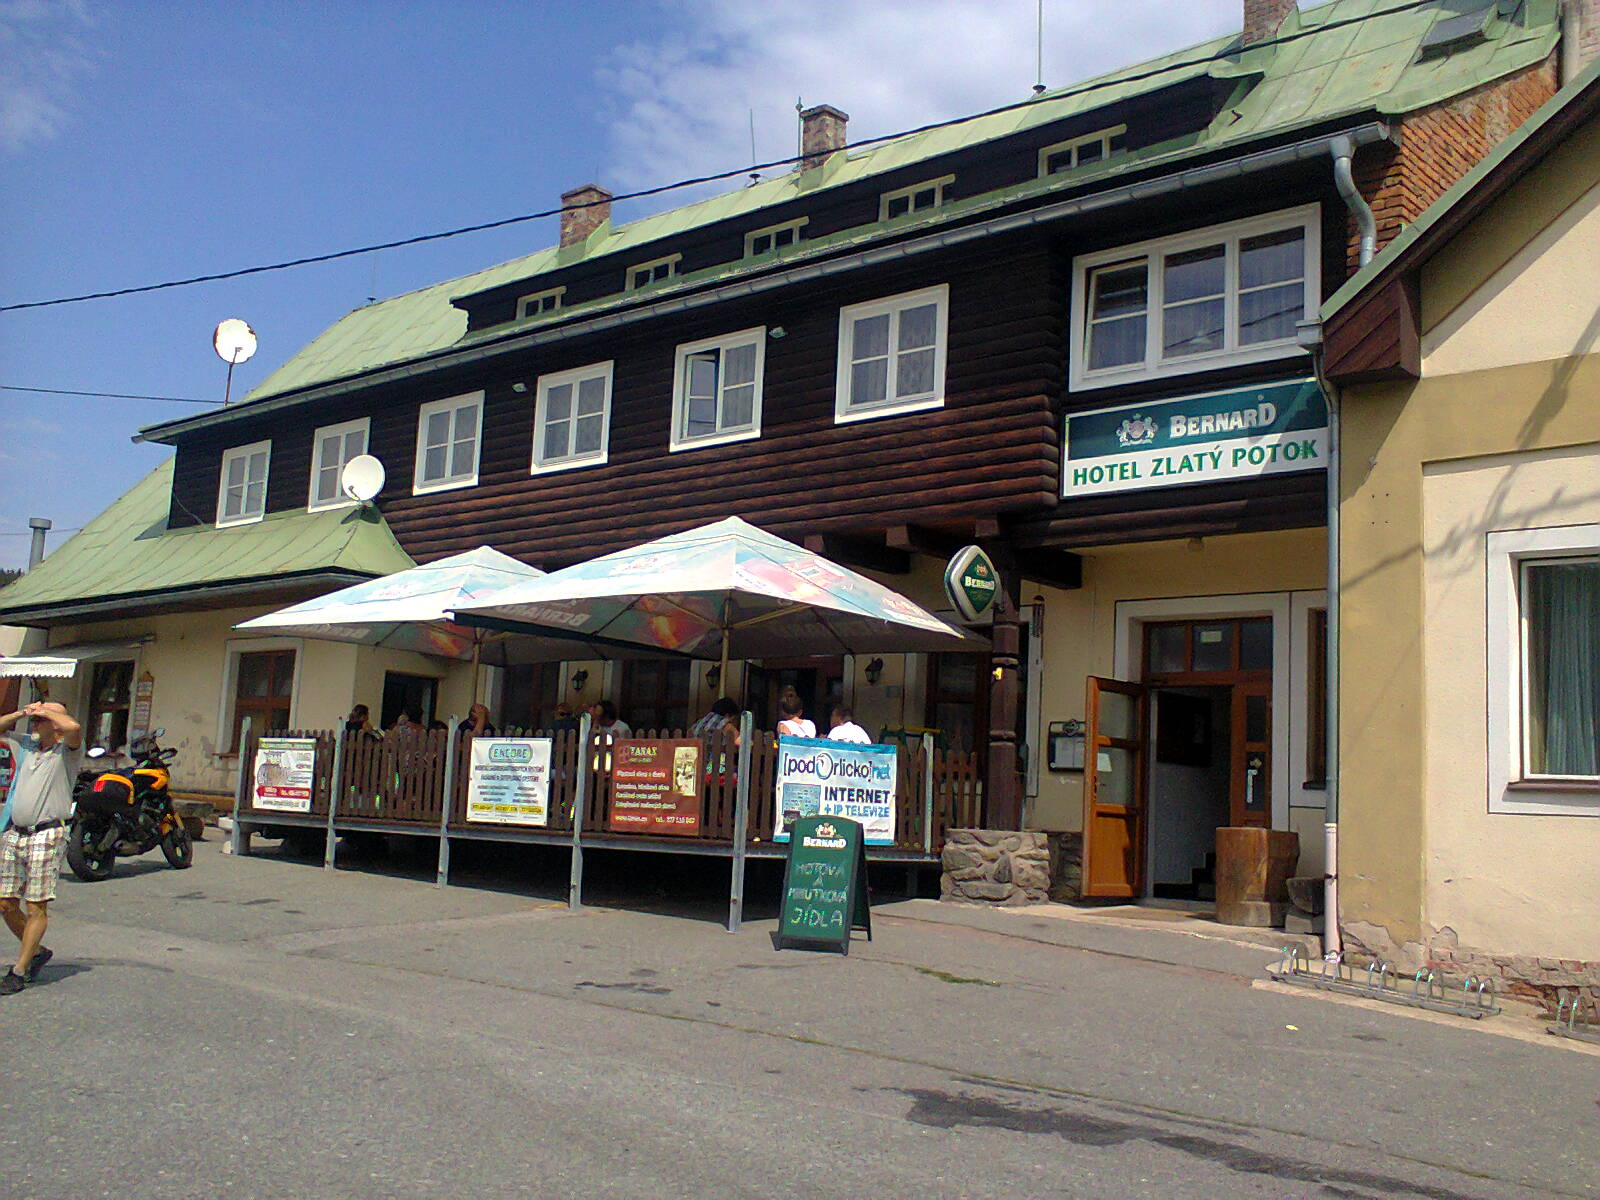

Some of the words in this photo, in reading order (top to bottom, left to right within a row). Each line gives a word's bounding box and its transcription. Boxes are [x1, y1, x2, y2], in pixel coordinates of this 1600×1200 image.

[1170, 399, 1277, 440] BERNARD
[1073, 461, 1142, 486] HOTEL
[1150, 445, 1222, 477] ZLATÝ
[1232, 438, 1318, 468] POTOK
[825, 786, 890, 804] INTERNET
[834, 804, 843, 815] IP
[845, 805, 889, 818] TELEVIZE
[803, 836, 847, 849] BERNARD
